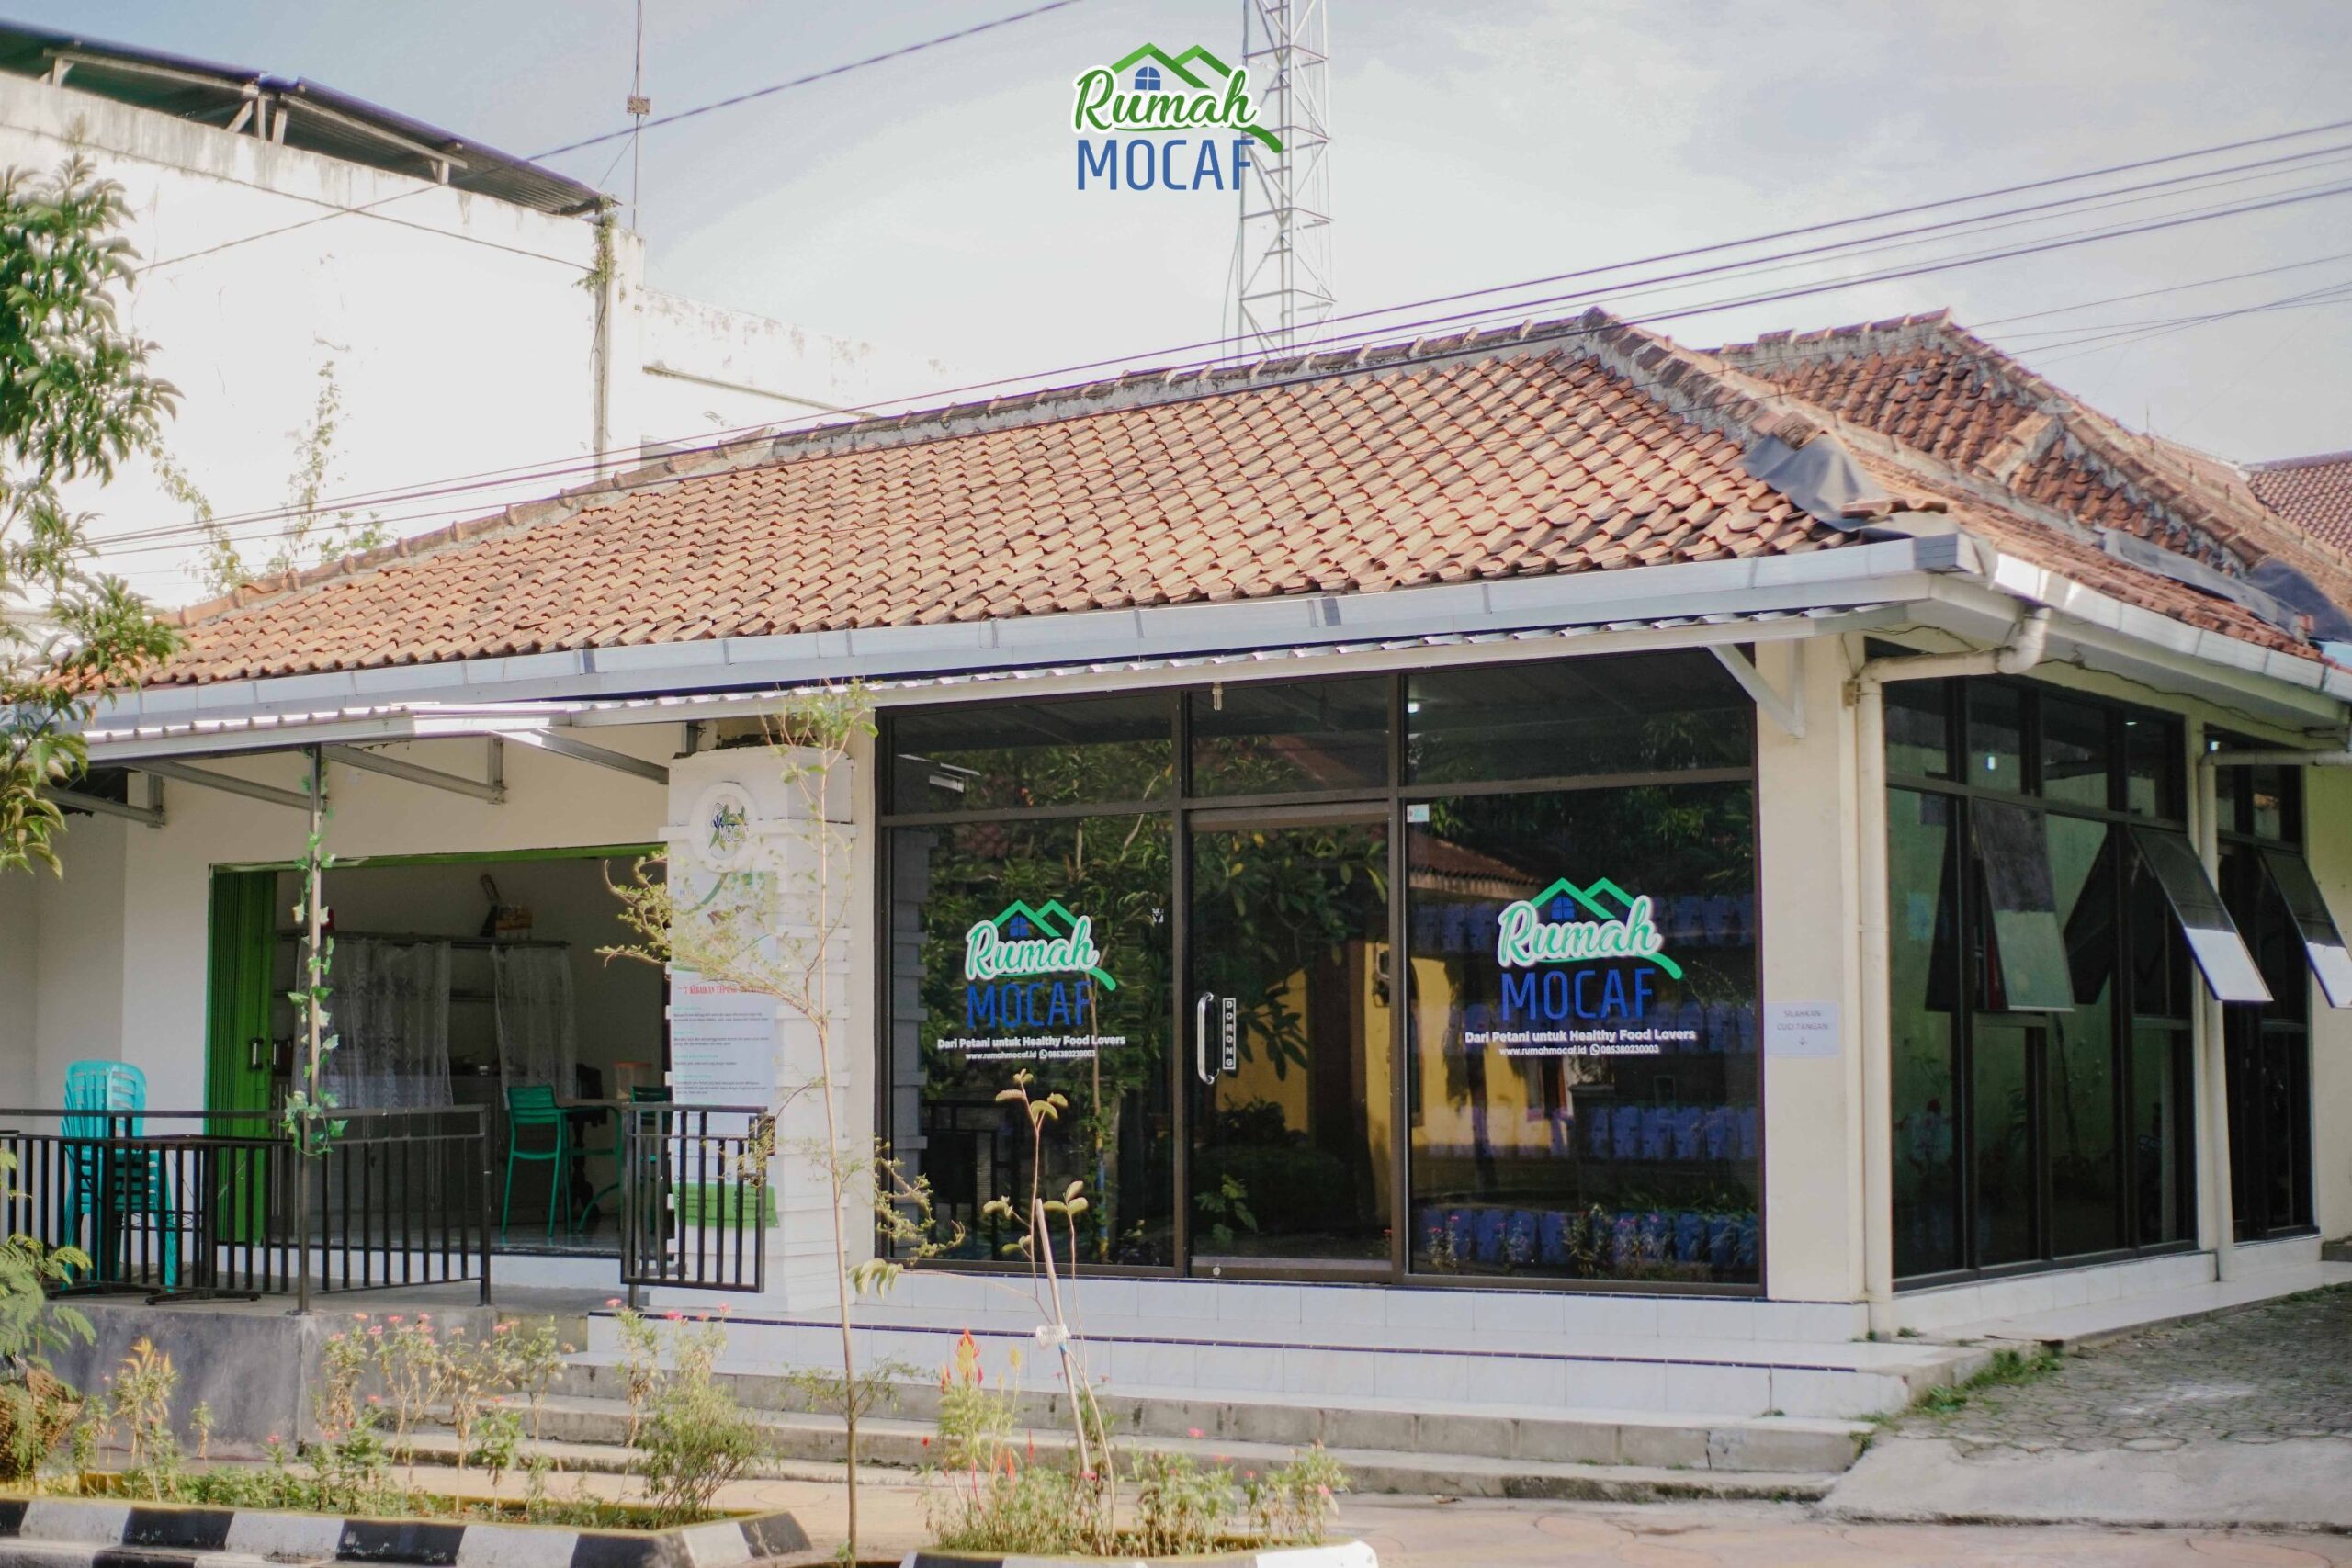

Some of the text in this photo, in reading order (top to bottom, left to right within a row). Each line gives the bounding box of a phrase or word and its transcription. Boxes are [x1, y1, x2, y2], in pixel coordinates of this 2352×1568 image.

[965, 915, 1100, 981] Rumah
[1498, 895, 1664, 967] Rumah
[967, 981, 1093, 1029] MOCAF
[1500, 968, 1655, 1021] MOCAF
[937, 1034, 1125, 1049] Dari Petani untuk Healthy Food Lovers
[1465, 1028, 1698, 1043] Dari Petani untuk Healthy Food Lovers
[1499, 1045, 1587, 1055] www.rumahmocaf.id
